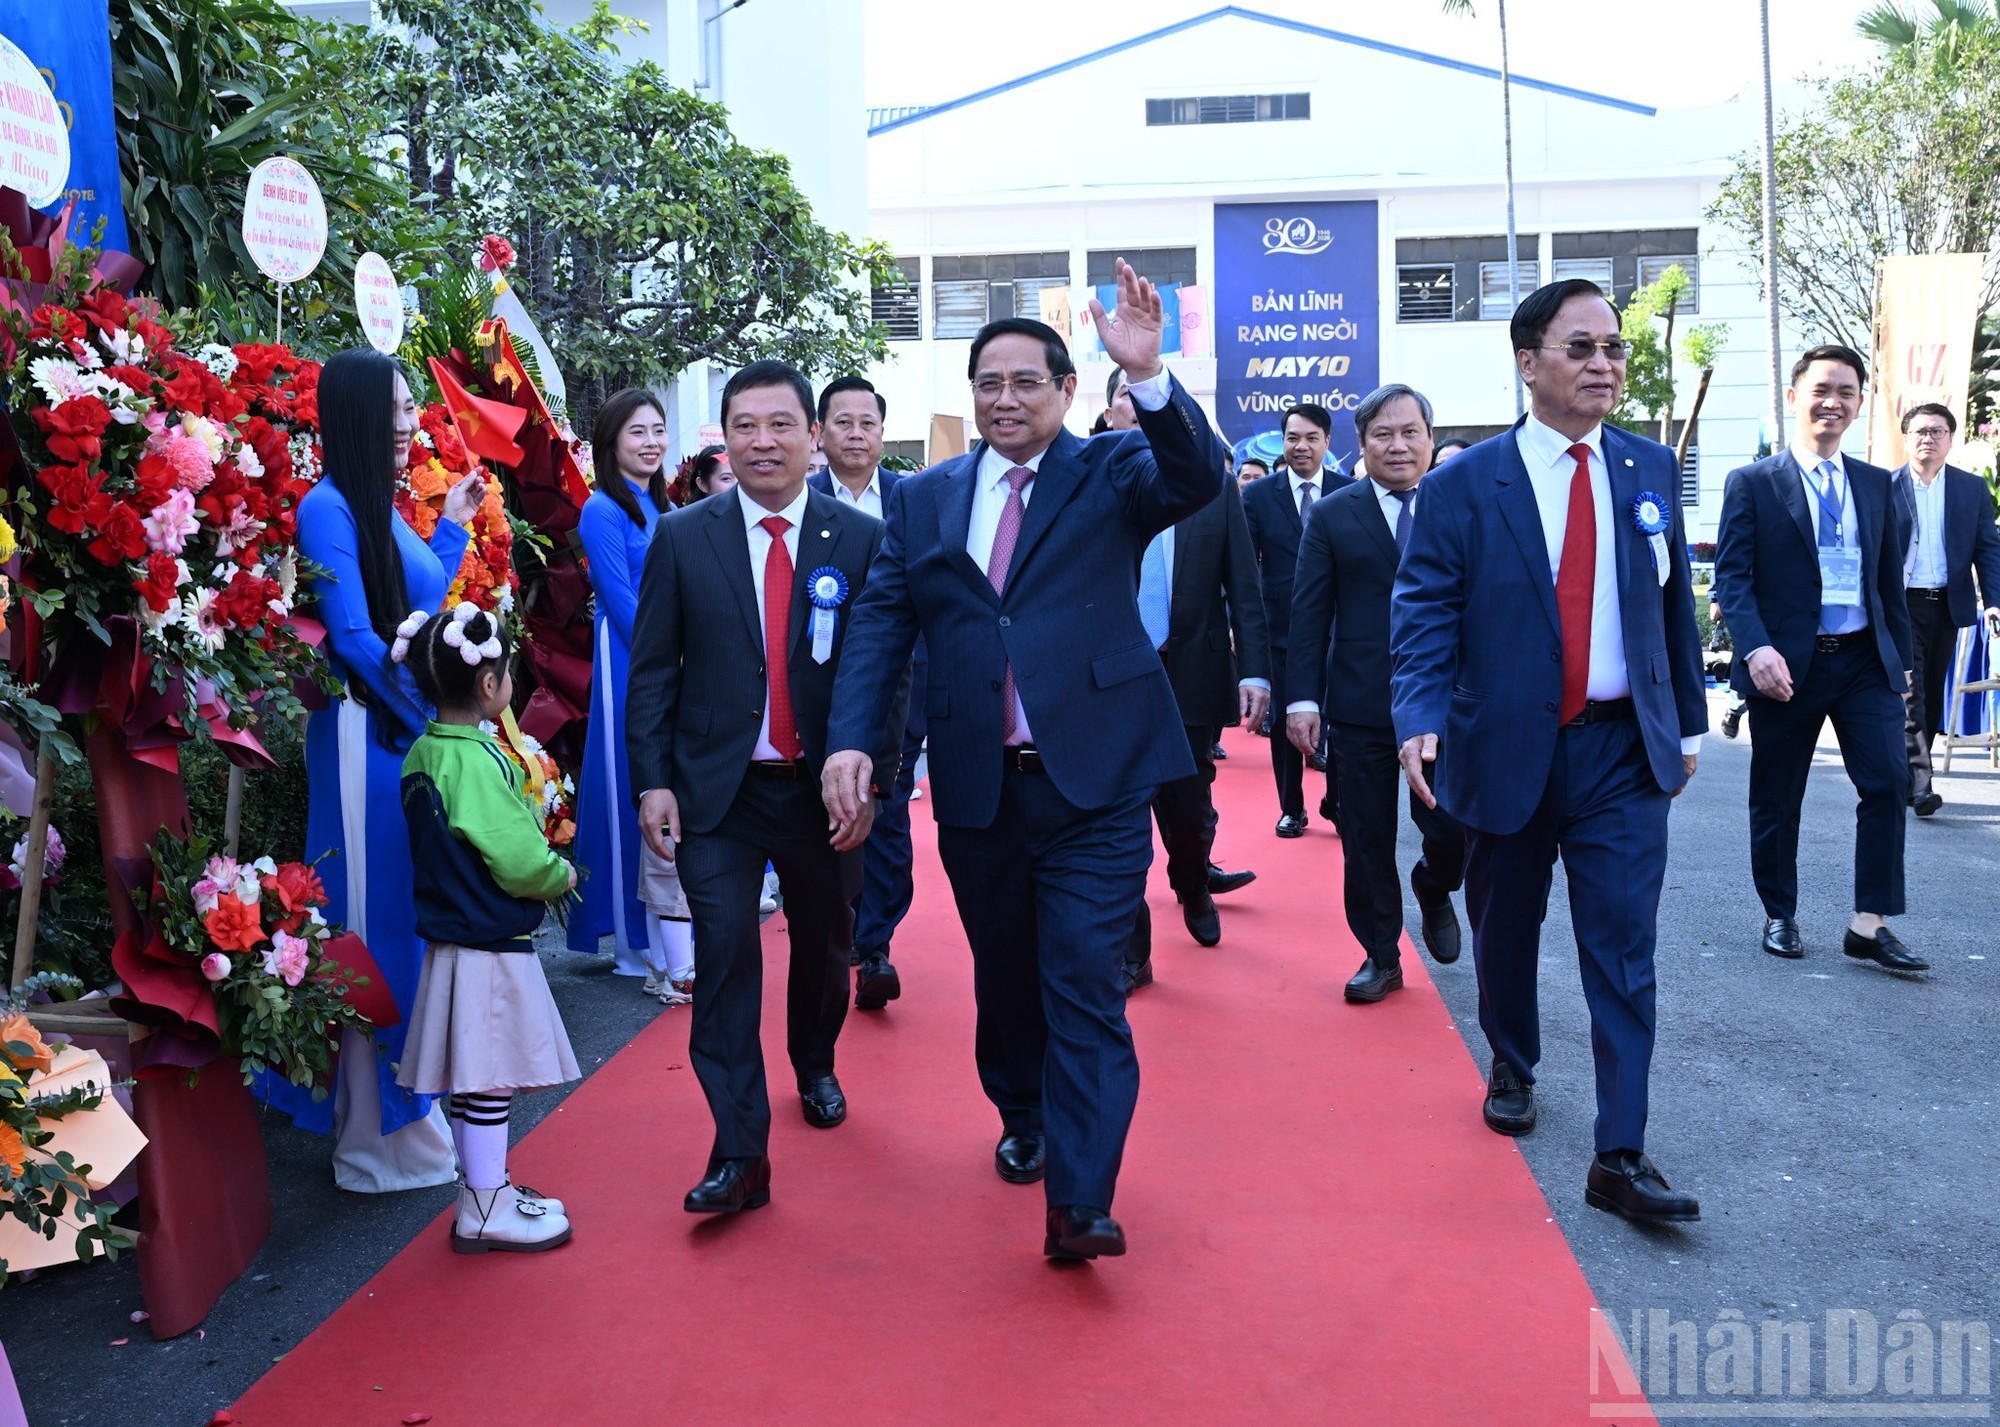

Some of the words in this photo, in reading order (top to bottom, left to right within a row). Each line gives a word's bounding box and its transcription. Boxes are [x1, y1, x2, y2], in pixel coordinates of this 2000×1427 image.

[1251, 288, 1294, 312] BẢN
[1299, 289, 1343, 312] LĨNH
[1238, 323, 1297, 346] RẠNG
[1302, 317, 1358, 341] NGỜI
[1245, 355, 1351, 378] MAY10
[1236, 390, 1297, 412] VỮNG
